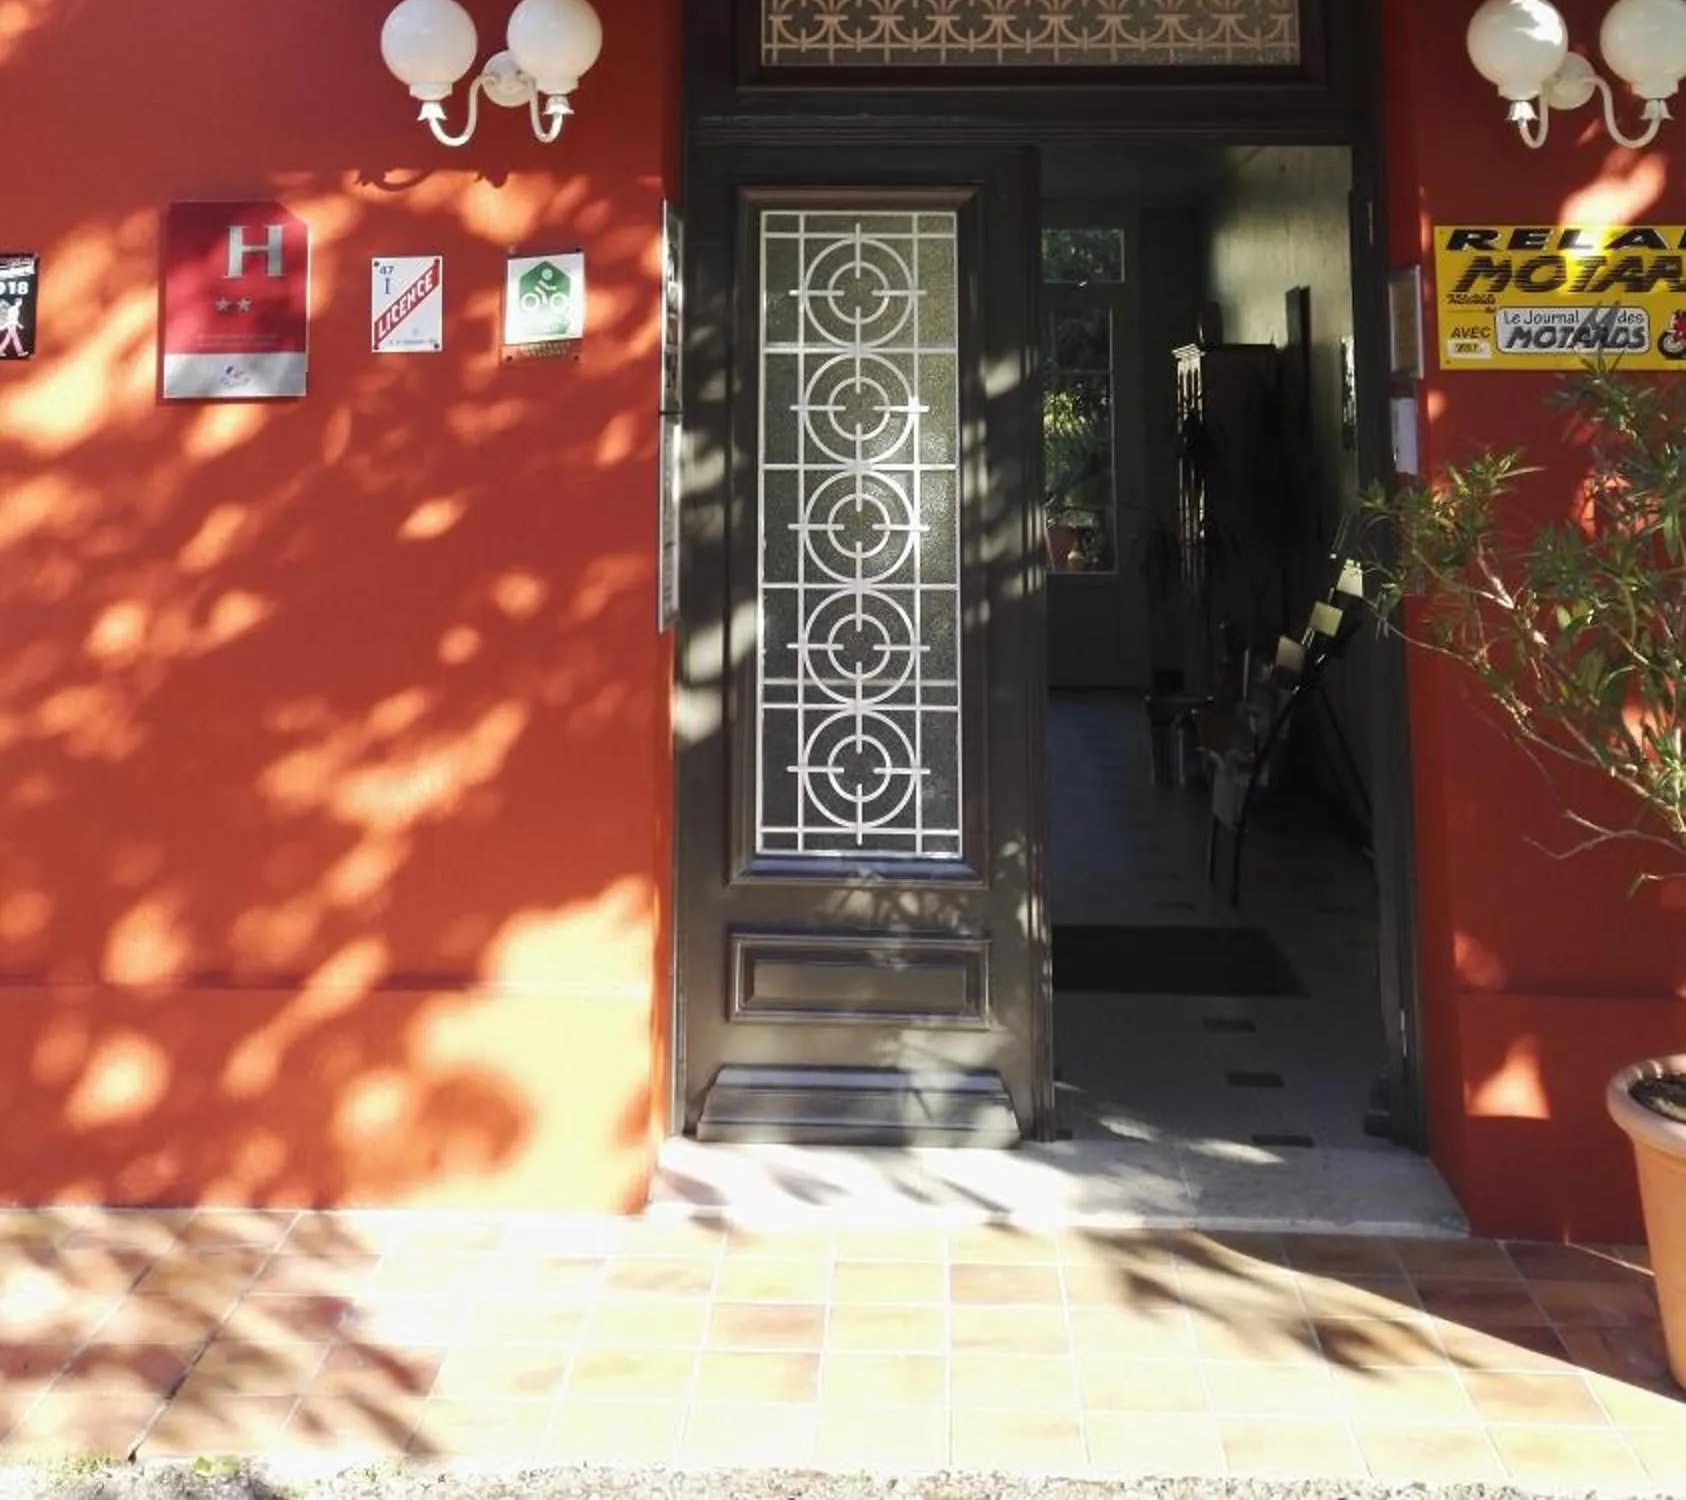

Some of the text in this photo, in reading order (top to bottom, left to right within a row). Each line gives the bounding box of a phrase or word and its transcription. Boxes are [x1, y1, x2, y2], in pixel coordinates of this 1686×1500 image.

[223, 225, 286, 279] H
[378, 269, 433, 339] LICENCE
[1504, 310, 1521, 325] Le
[1524, 310, 1579, 325] Journal
[1618, 309, 1645, 324] des
[1451, 327, 1492, 339] AVEC
